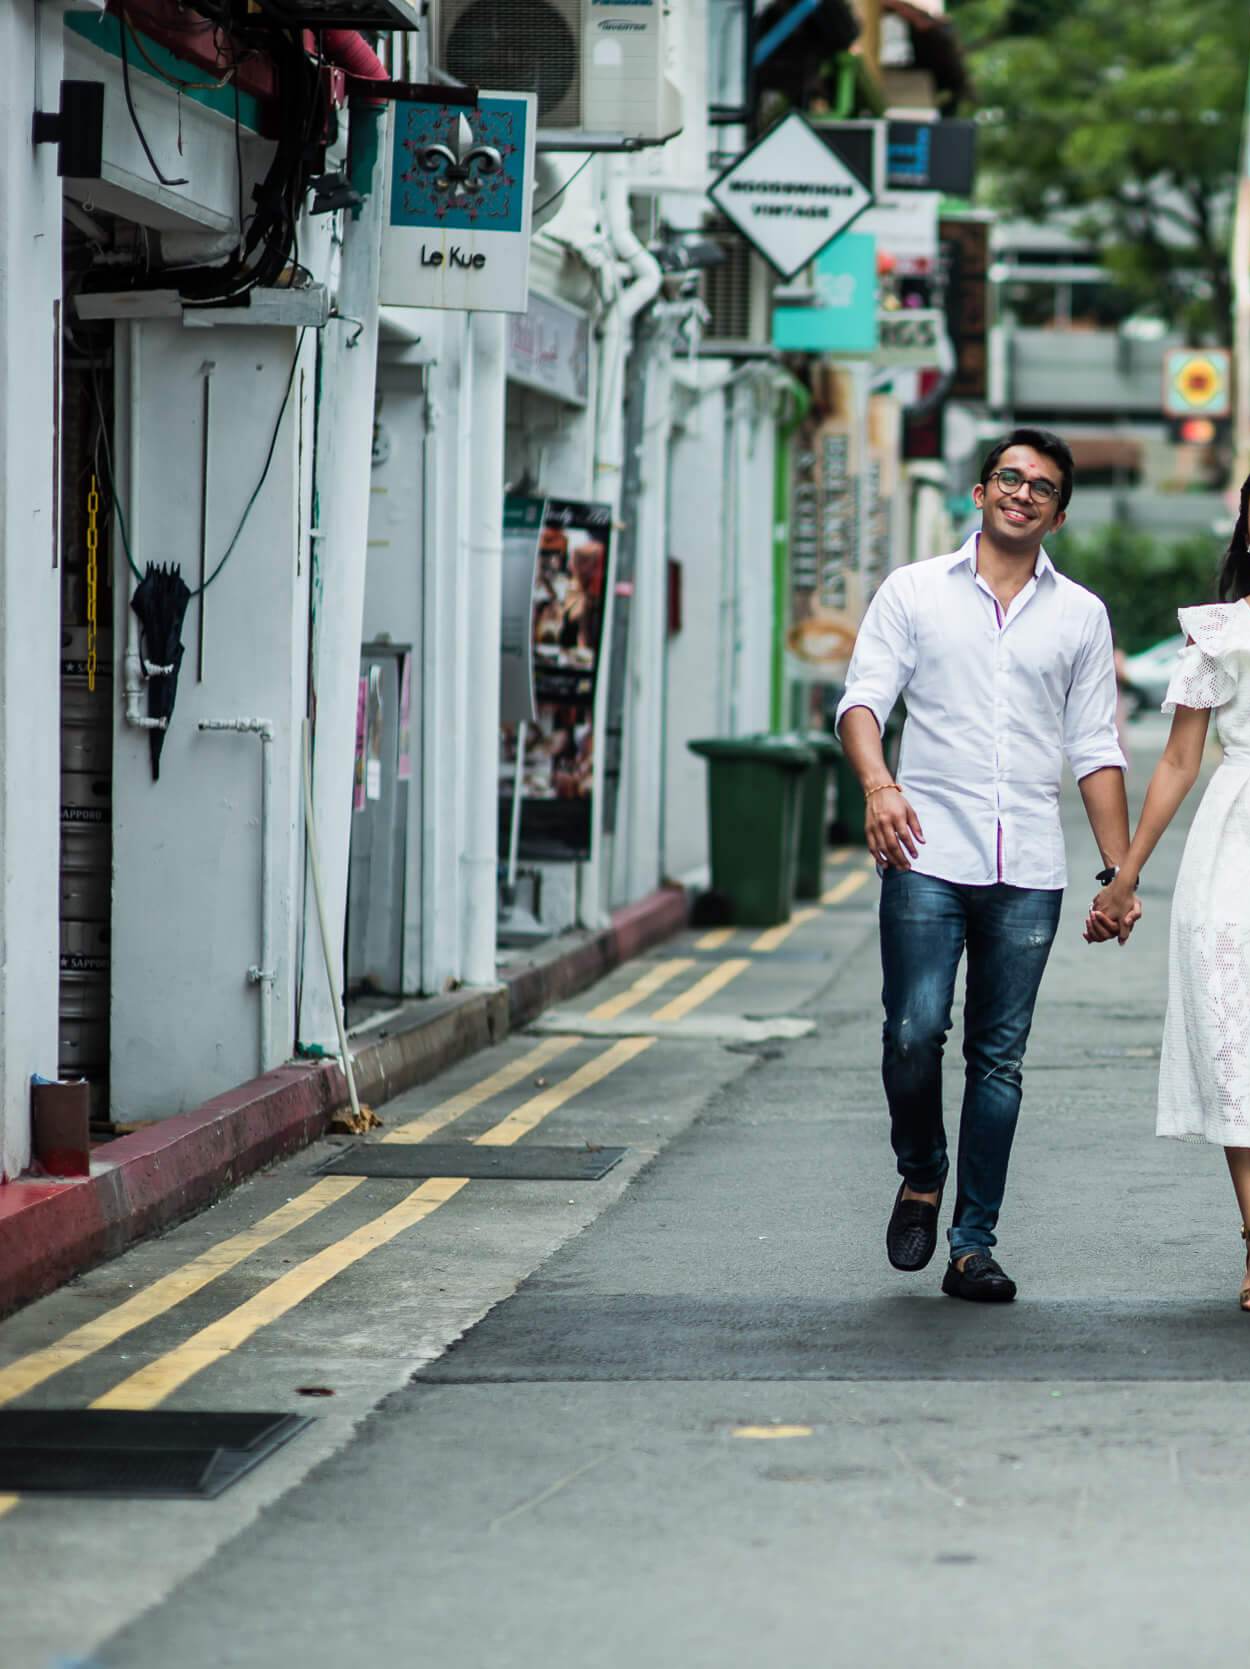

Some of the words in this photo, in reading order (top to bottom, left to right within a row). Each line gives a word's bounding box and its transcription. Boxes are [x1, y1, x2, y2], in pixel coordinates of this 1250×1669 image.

[752, 204, 830, 218] VINTAGE
[421, 244, 444, 266] Le
[449, 246, 487, 269] Kue
